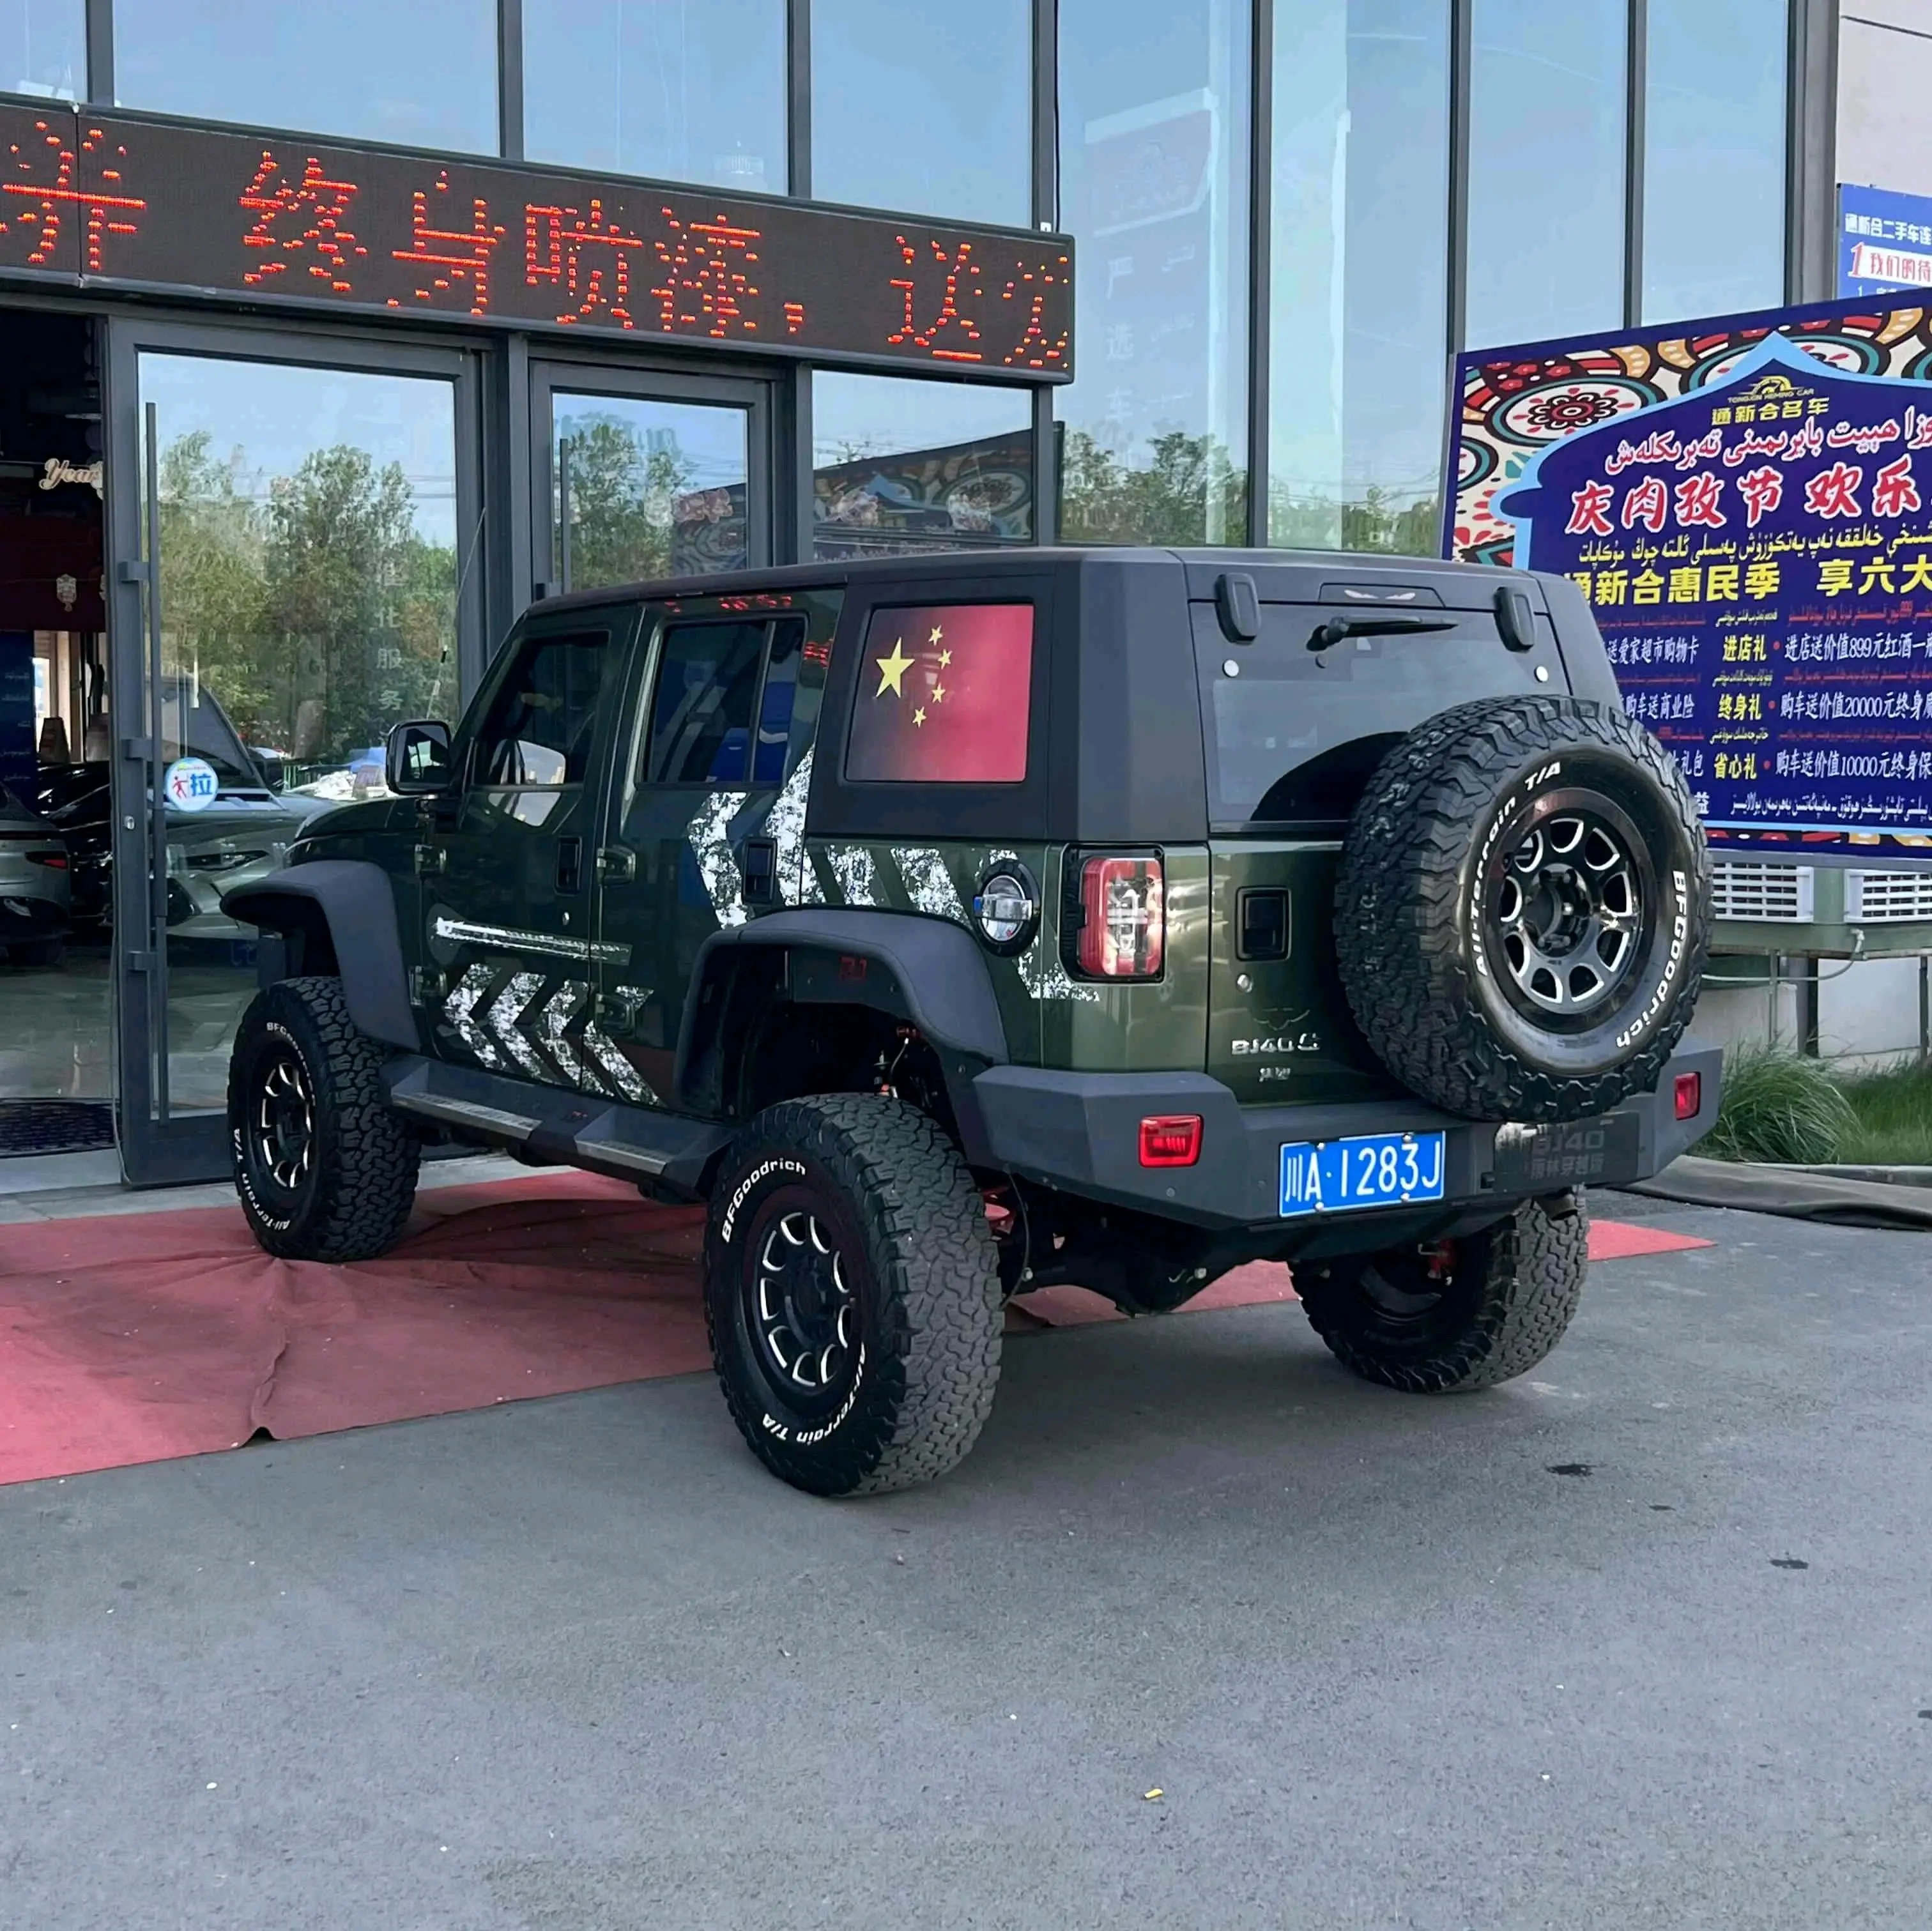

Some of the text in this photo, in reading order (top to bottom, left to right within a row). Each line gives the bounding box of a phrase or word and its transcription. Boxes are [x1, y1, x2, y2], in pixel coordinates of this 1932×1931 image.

[1712, 397, 1830, 426] 通新合名车
[1804, 454, 1921, 519] 欢乐
[1816, 553, 1932, 597] 享六大
[1722, 634, 1767, 662] 进店礼
[1620, 692, 1695, 721] 购车送商业险
[1717, 693, 1762, 721] 终身礼
[1524, 761, 1561, 791] T/A
[1714, 752, 1757, 780] 省心礼
[1615, 869, 1687, 1048] BFGoodrich
[722, 1157, 806, 1242] BFGoodrich
[762, 1413, 789, 1441] T/A
